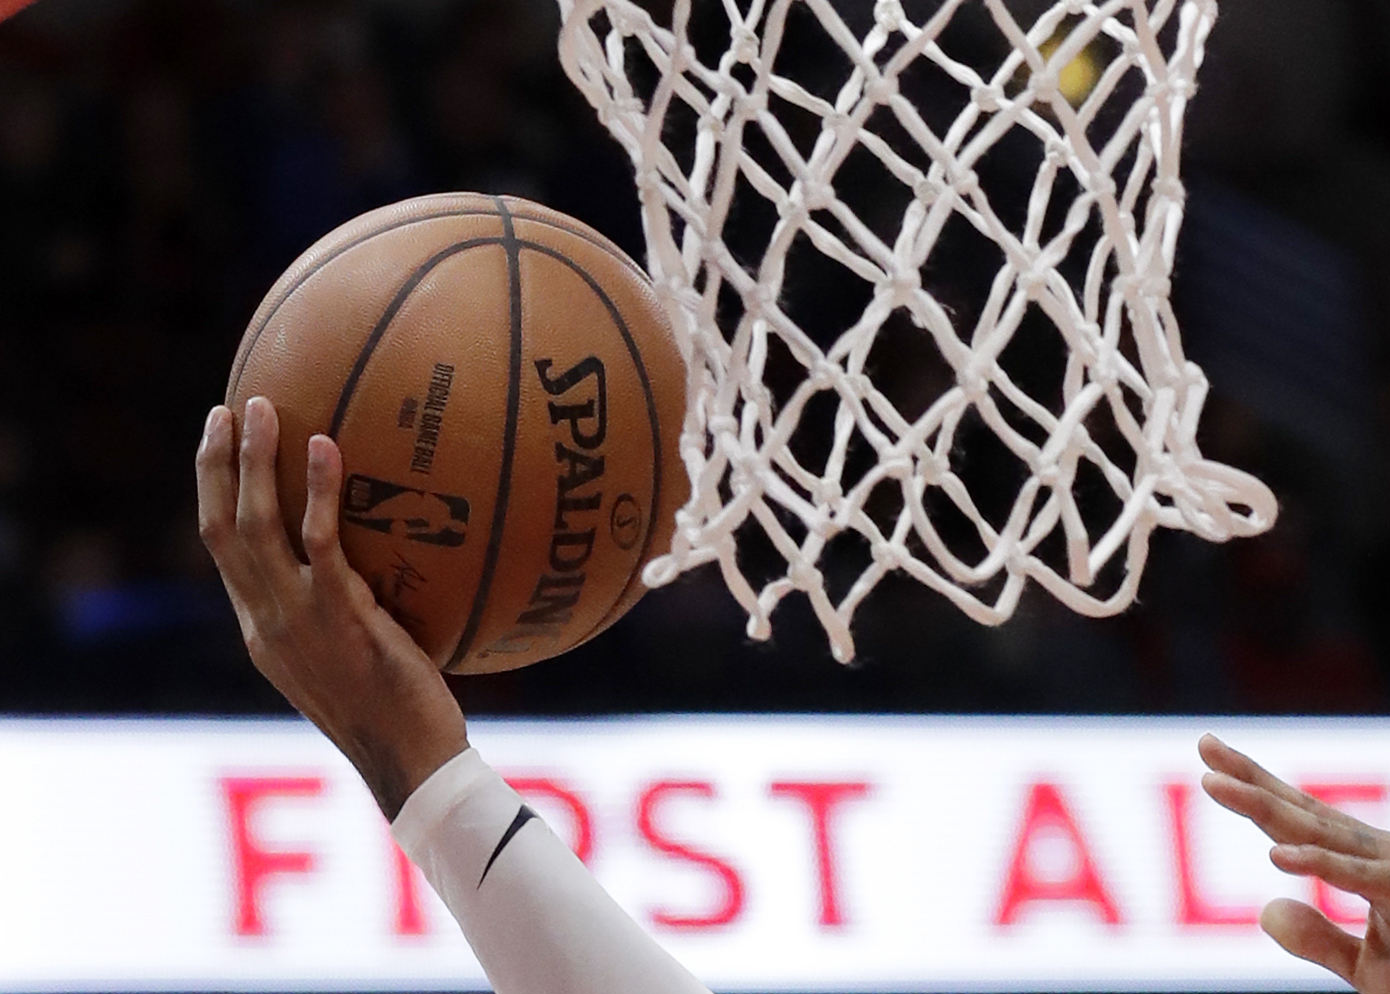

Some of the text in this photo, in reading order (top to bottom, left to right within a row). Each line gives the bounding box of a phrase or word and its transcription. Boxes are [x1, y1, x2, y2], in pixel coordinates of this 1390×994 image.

[411, 362, 455, 475] OFFICIAL GAME BALL
